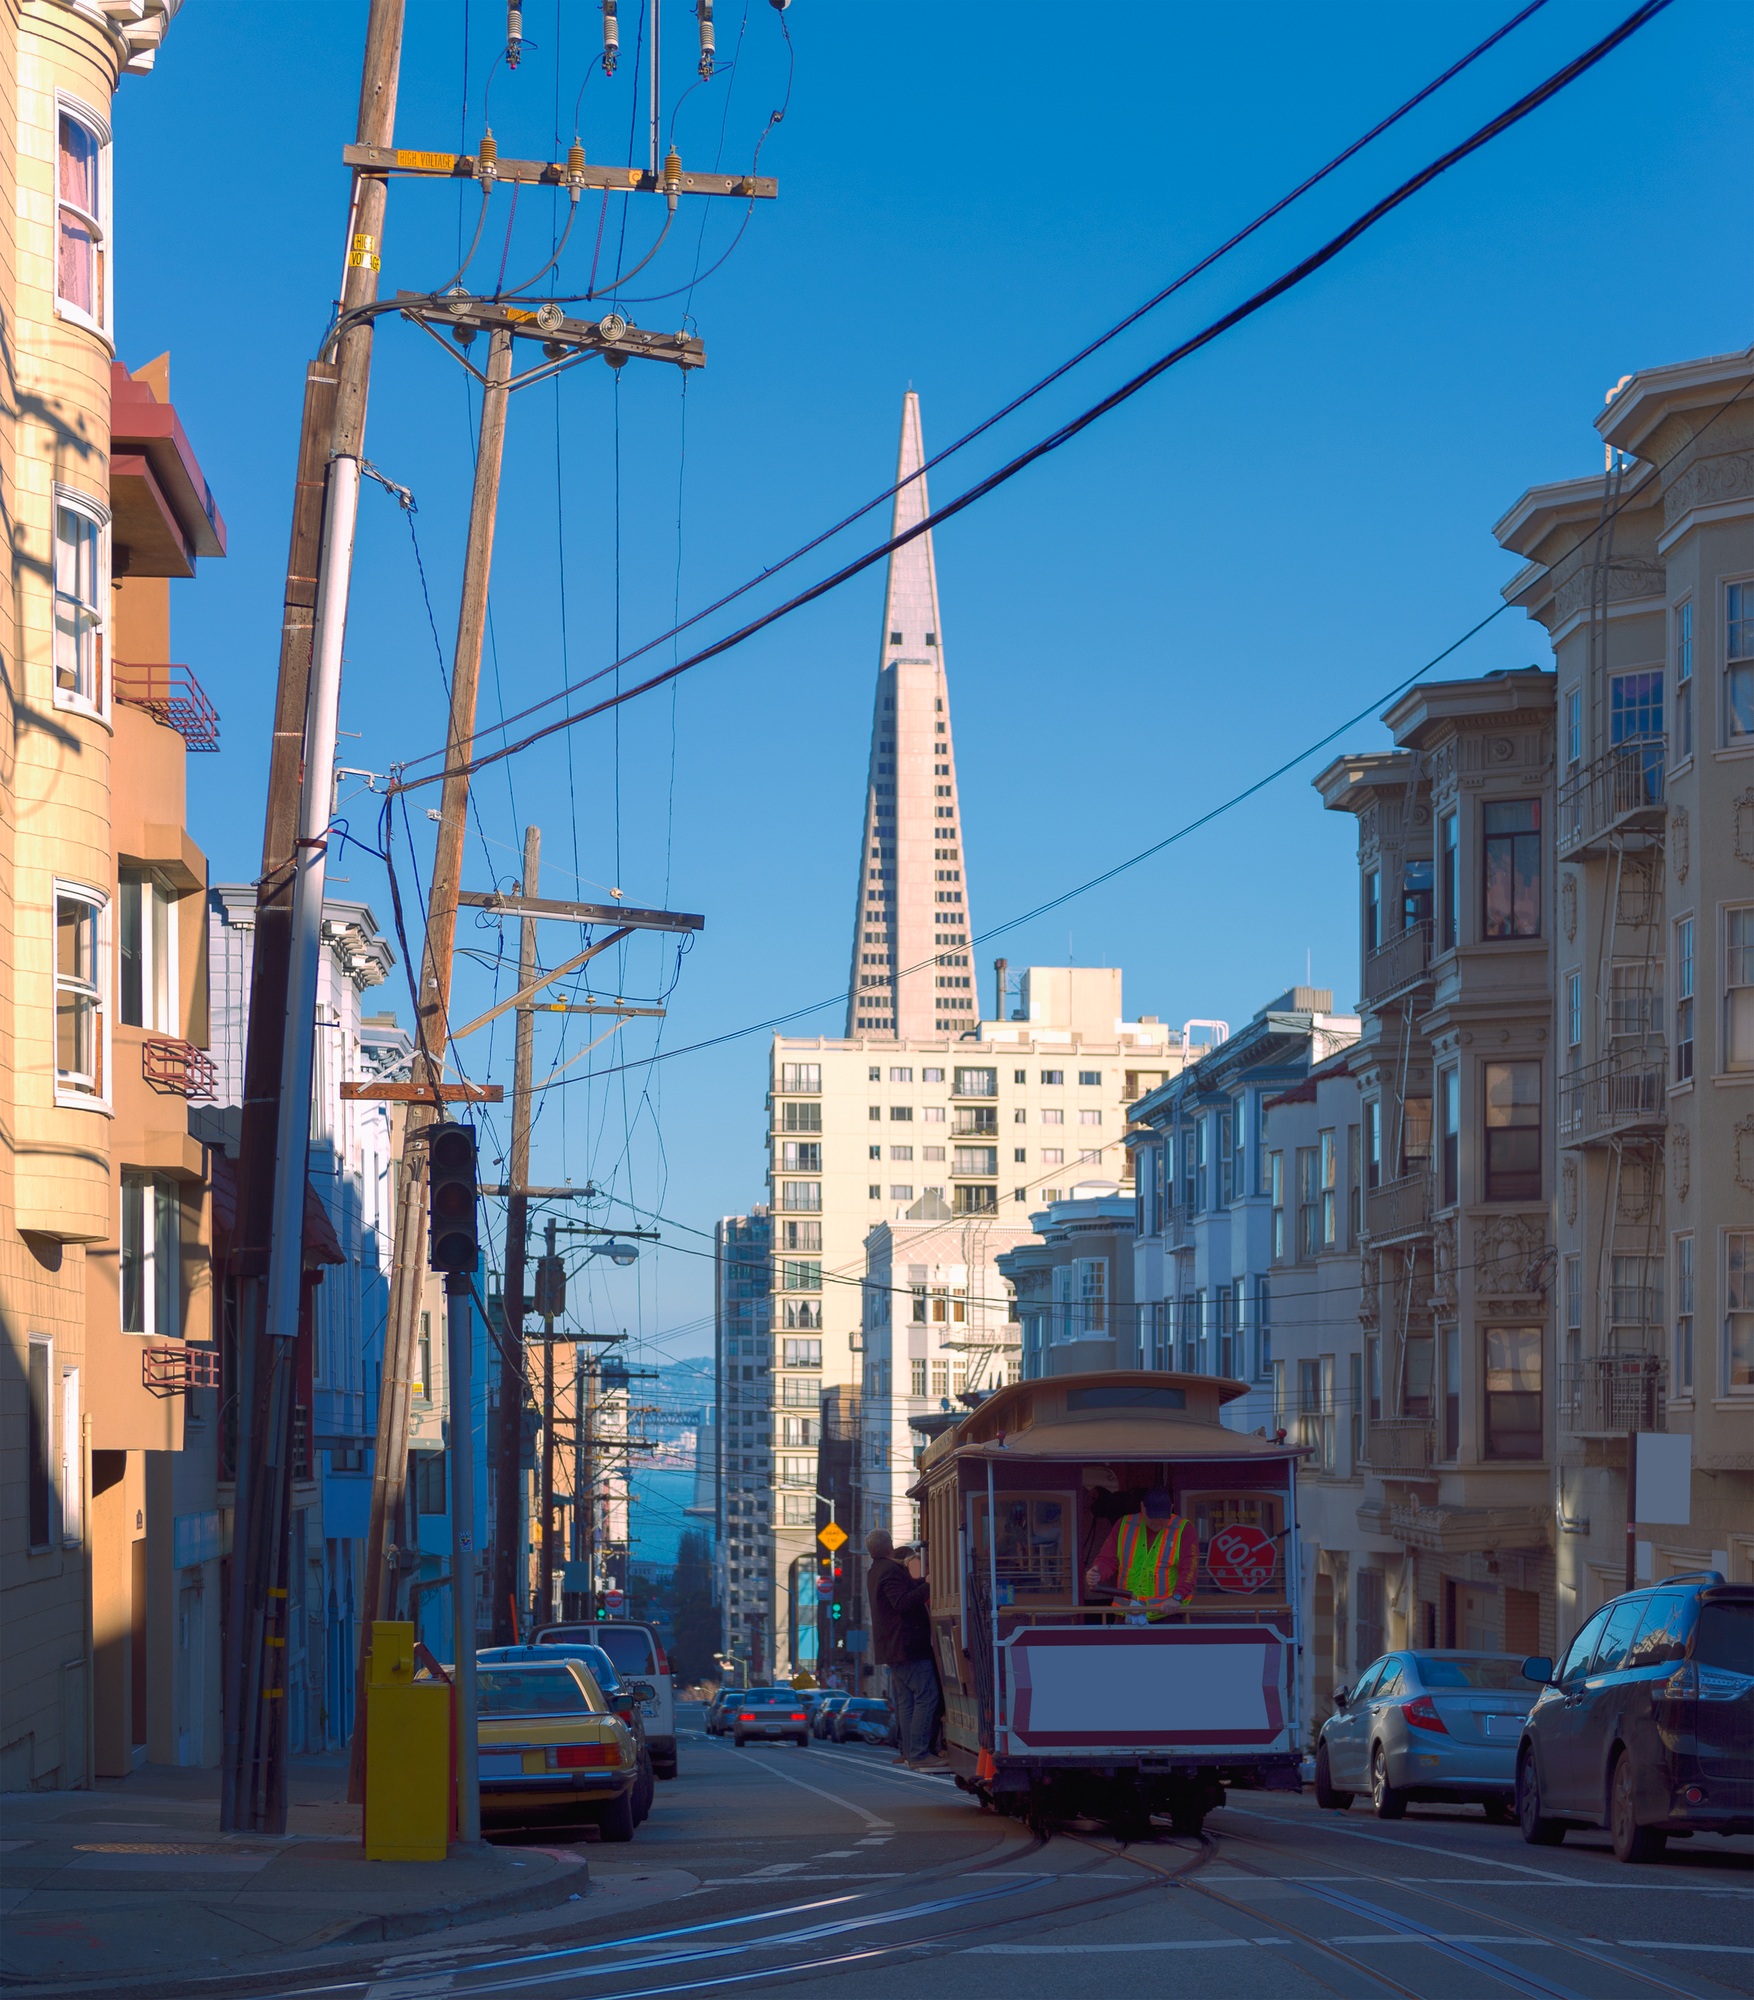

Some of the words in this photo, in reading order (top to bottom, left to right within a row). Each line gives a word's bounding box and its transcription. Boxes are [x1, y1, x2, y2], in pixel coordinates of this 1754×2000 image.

[399, 151, 417, 166] HIGH
[420, 153, 452, 169] VOLTAGE
[462, 158, 471, 168] A
[550, 167, 559, 176] B
[631, 172, 640, 182] C
[352, 252, 379, 272] VOLAGE
[1217, 1534, 1266, 1587] STOP
